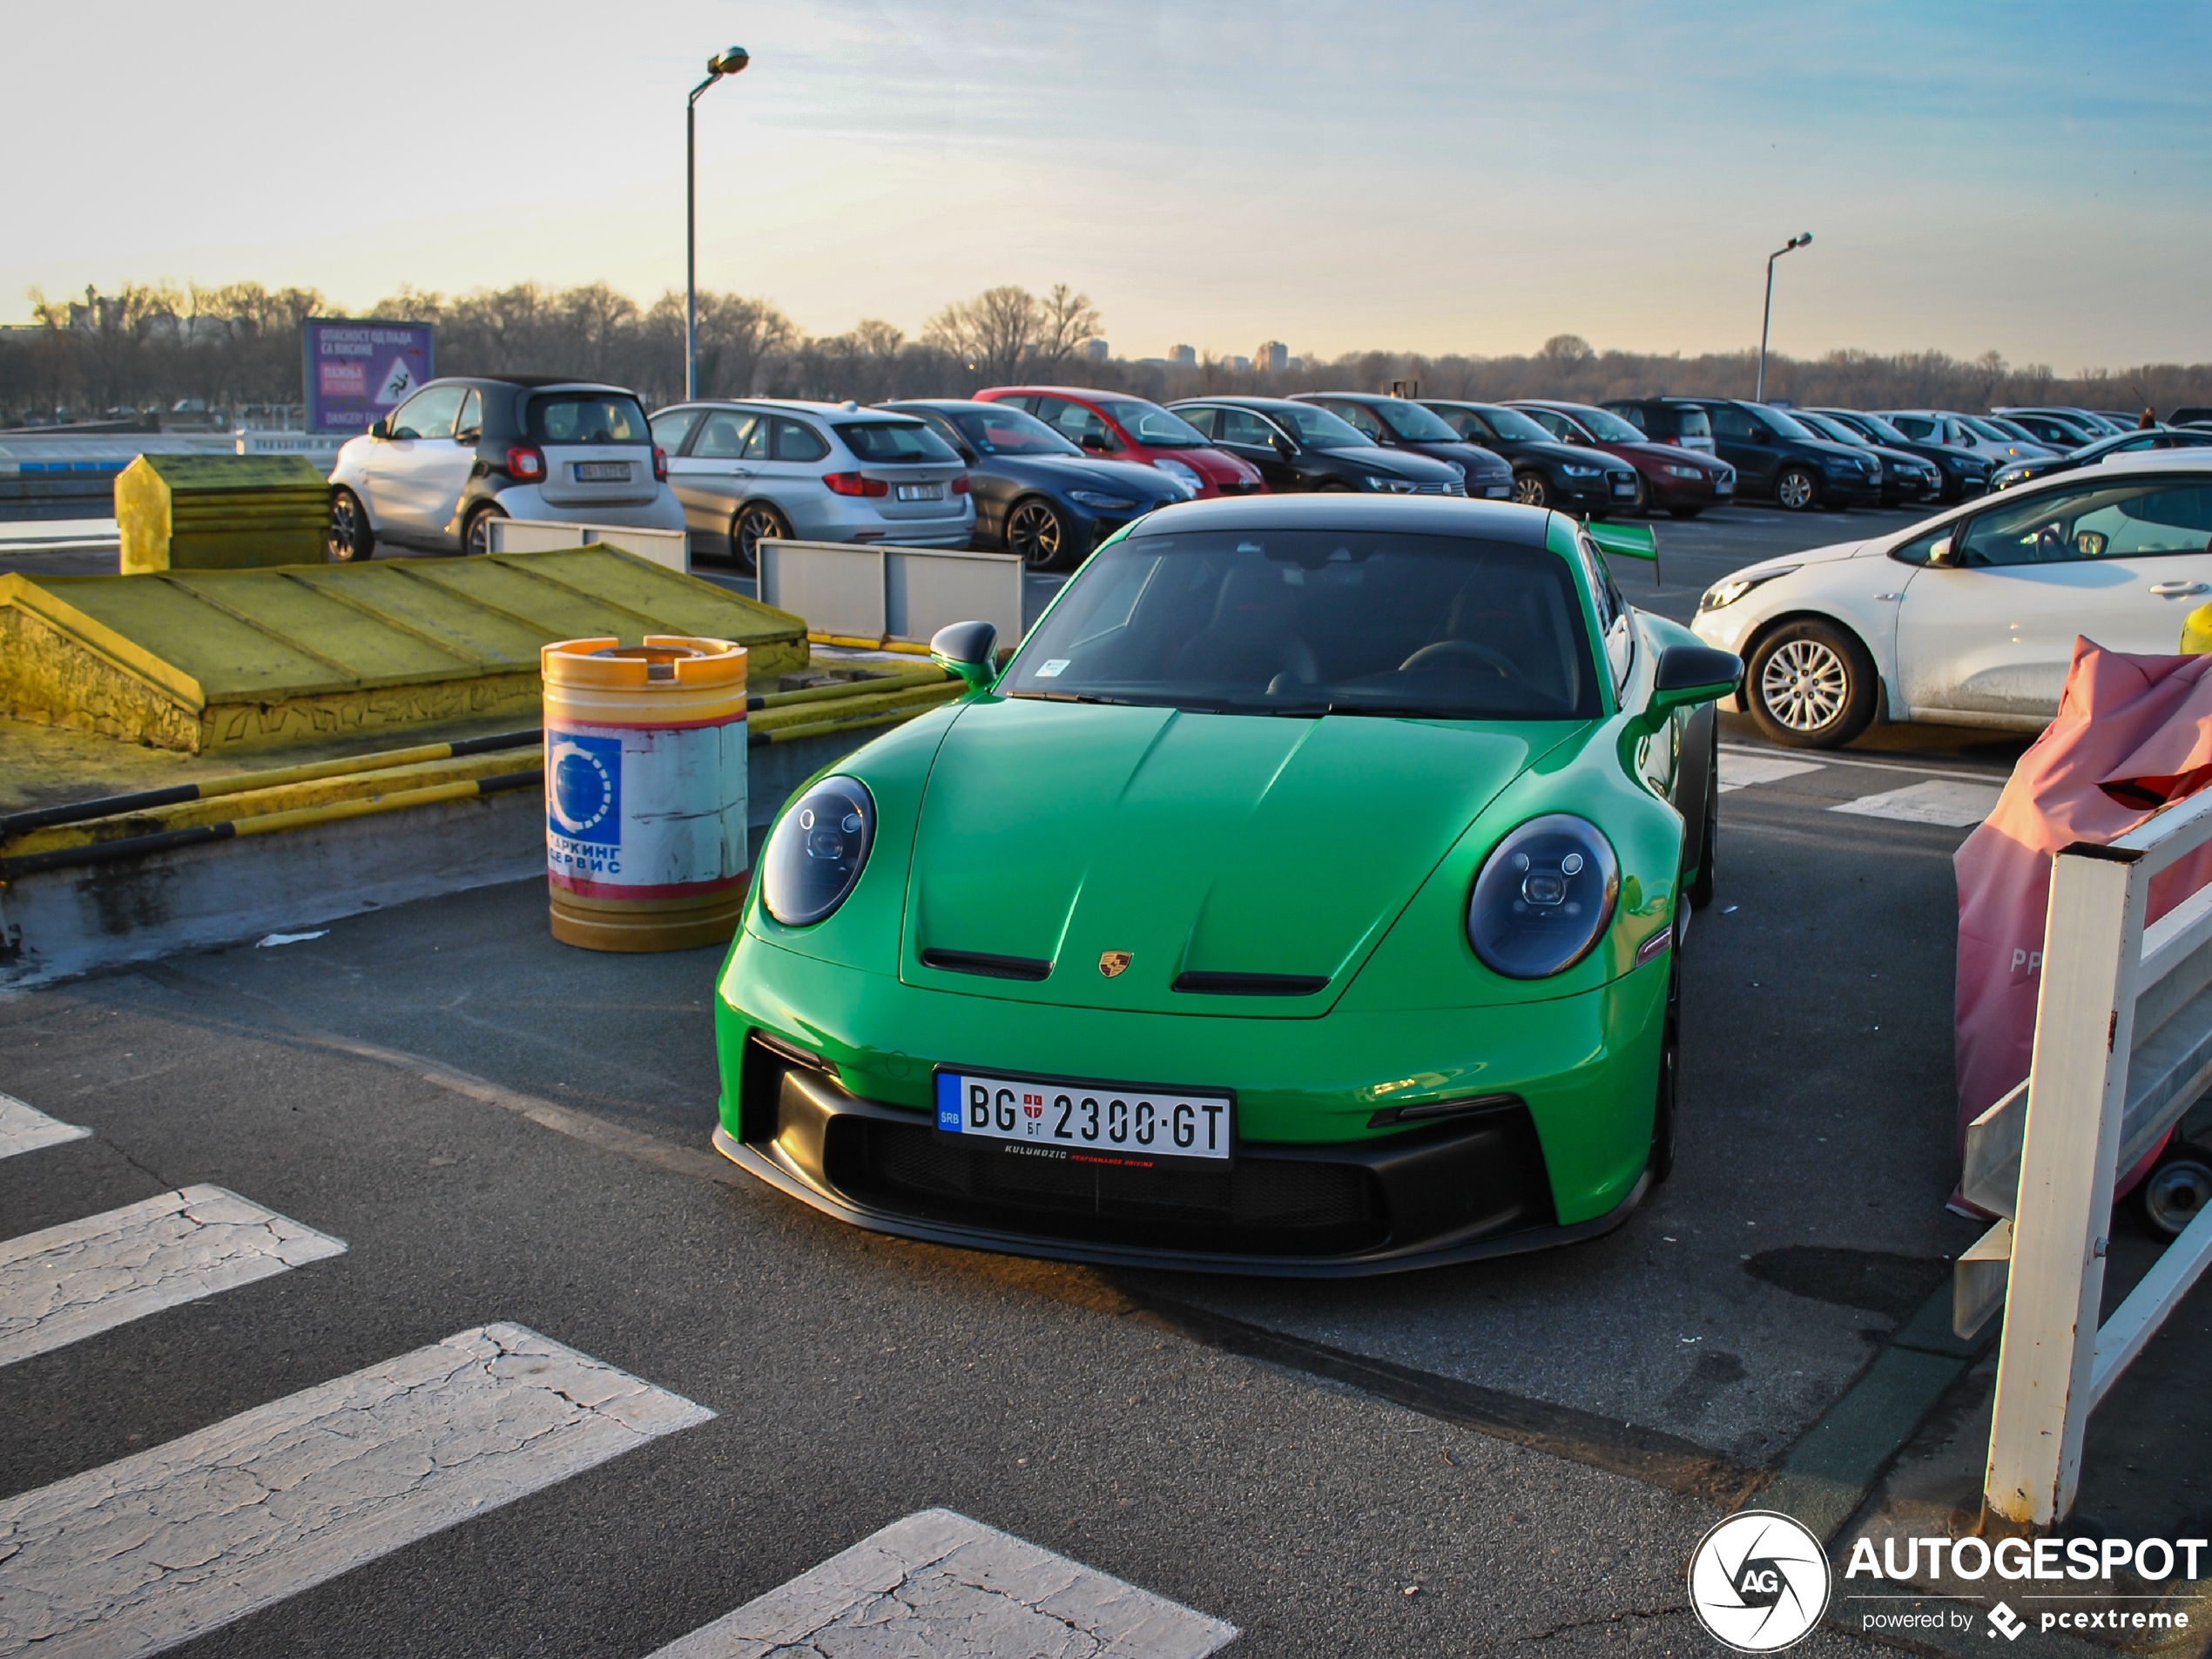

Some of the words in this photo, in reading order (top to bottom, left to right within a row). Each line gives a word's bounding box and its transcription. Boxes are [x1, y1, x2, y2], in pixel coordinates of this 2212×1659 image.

[550, 834, 621, 860] АРКИНГ
[969, 1083, 1016, 1131] BG
[941, 1111, 960, 1125] SRB
[1071, 1155, 1122, 1165] PERFORMANCE
